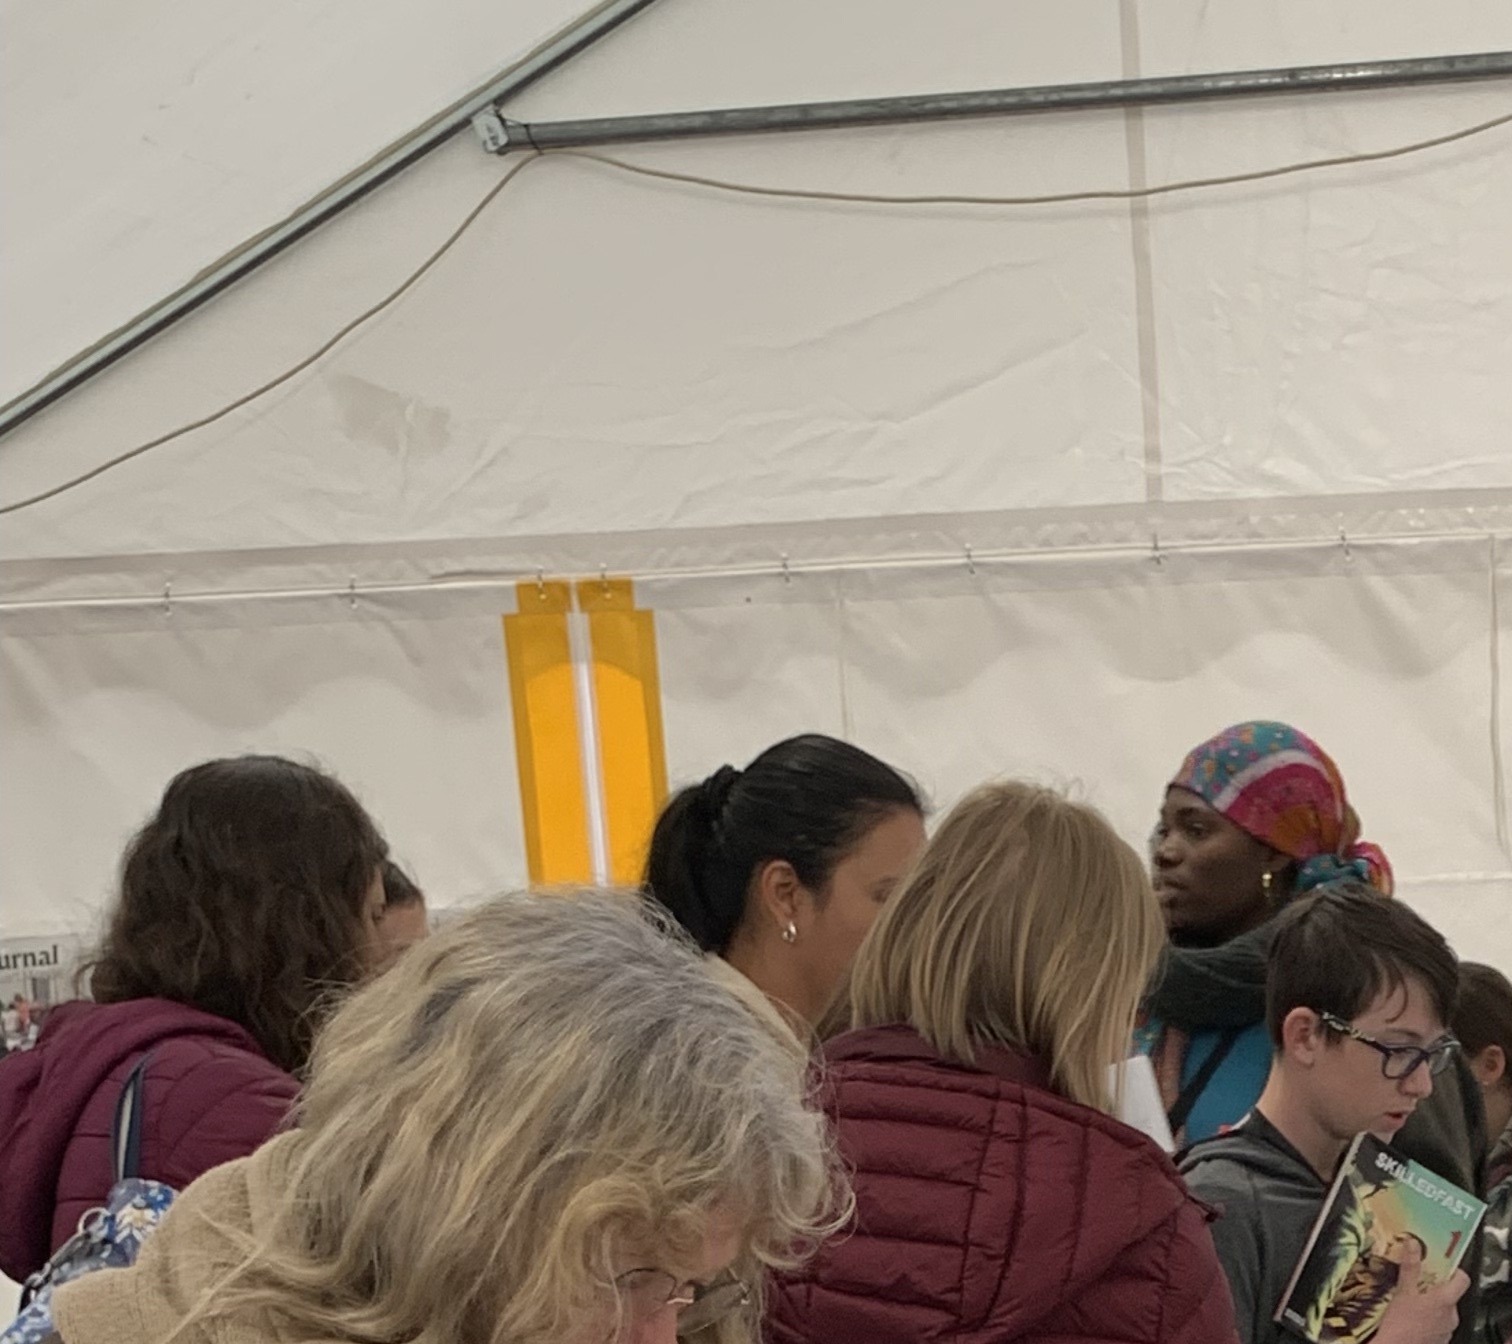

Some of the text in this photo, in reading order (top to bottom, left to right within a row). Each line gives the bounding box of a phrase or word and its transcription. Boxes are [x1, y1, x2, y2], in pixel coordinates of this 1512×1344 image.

[0, 944, 58, 970] urnal
[1375, 1151, 1475, 1220] SKILLEDFAST
[1444, 1230, 1462, 1259] 1
